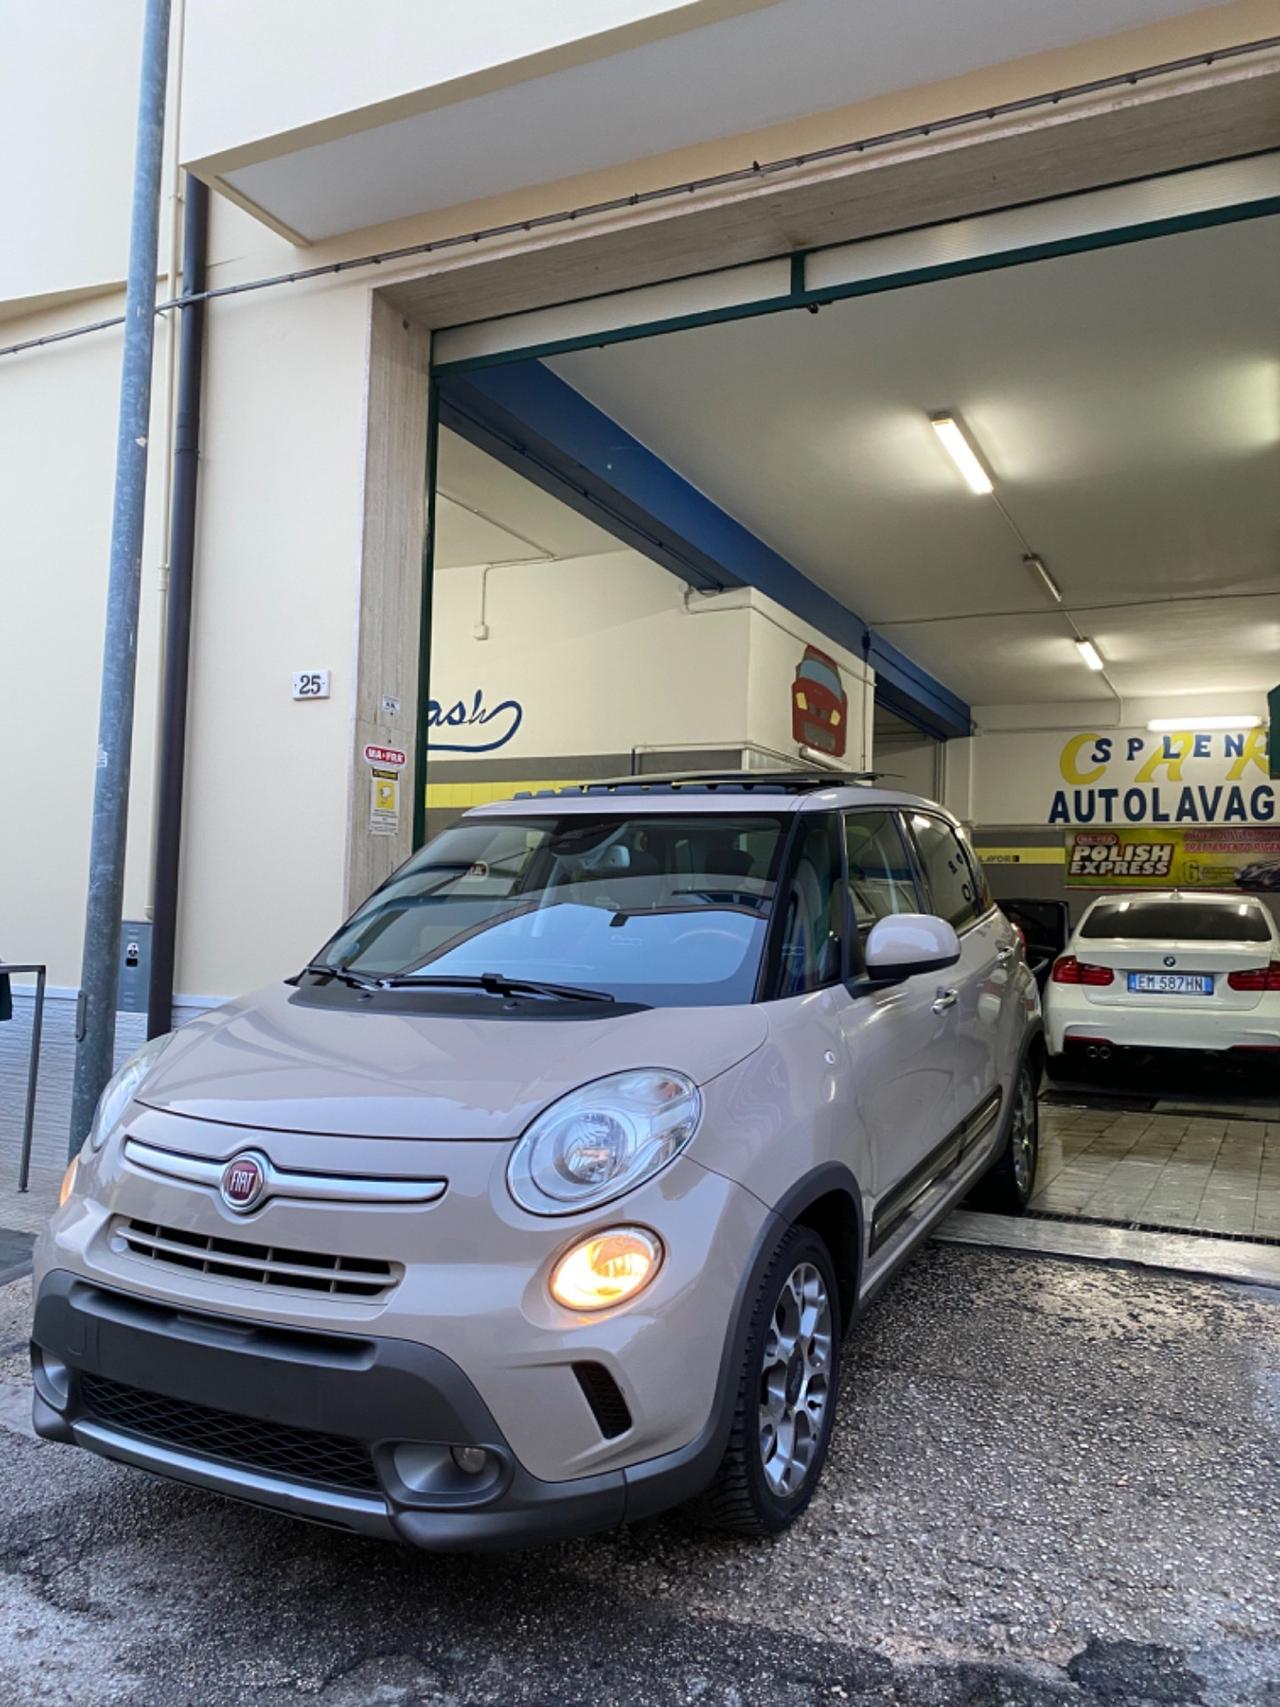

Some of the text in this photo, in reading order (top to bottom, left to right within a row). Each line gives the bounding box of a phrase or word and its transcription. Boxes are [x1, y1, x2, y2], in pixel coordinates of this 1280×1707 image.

[299, 675, 321, 695] 25
[1091, 733, 1270, 763] SPLEN
[1048, 785, 1275, 824] AUTOLAVAG
[1072, 845, 1172, 861] POLISH
[1070, 861, 1169, 875] EXPRESS
[1138, 975, 1155, 989] EM
[230, 1170, 255, 1194] FIAT
